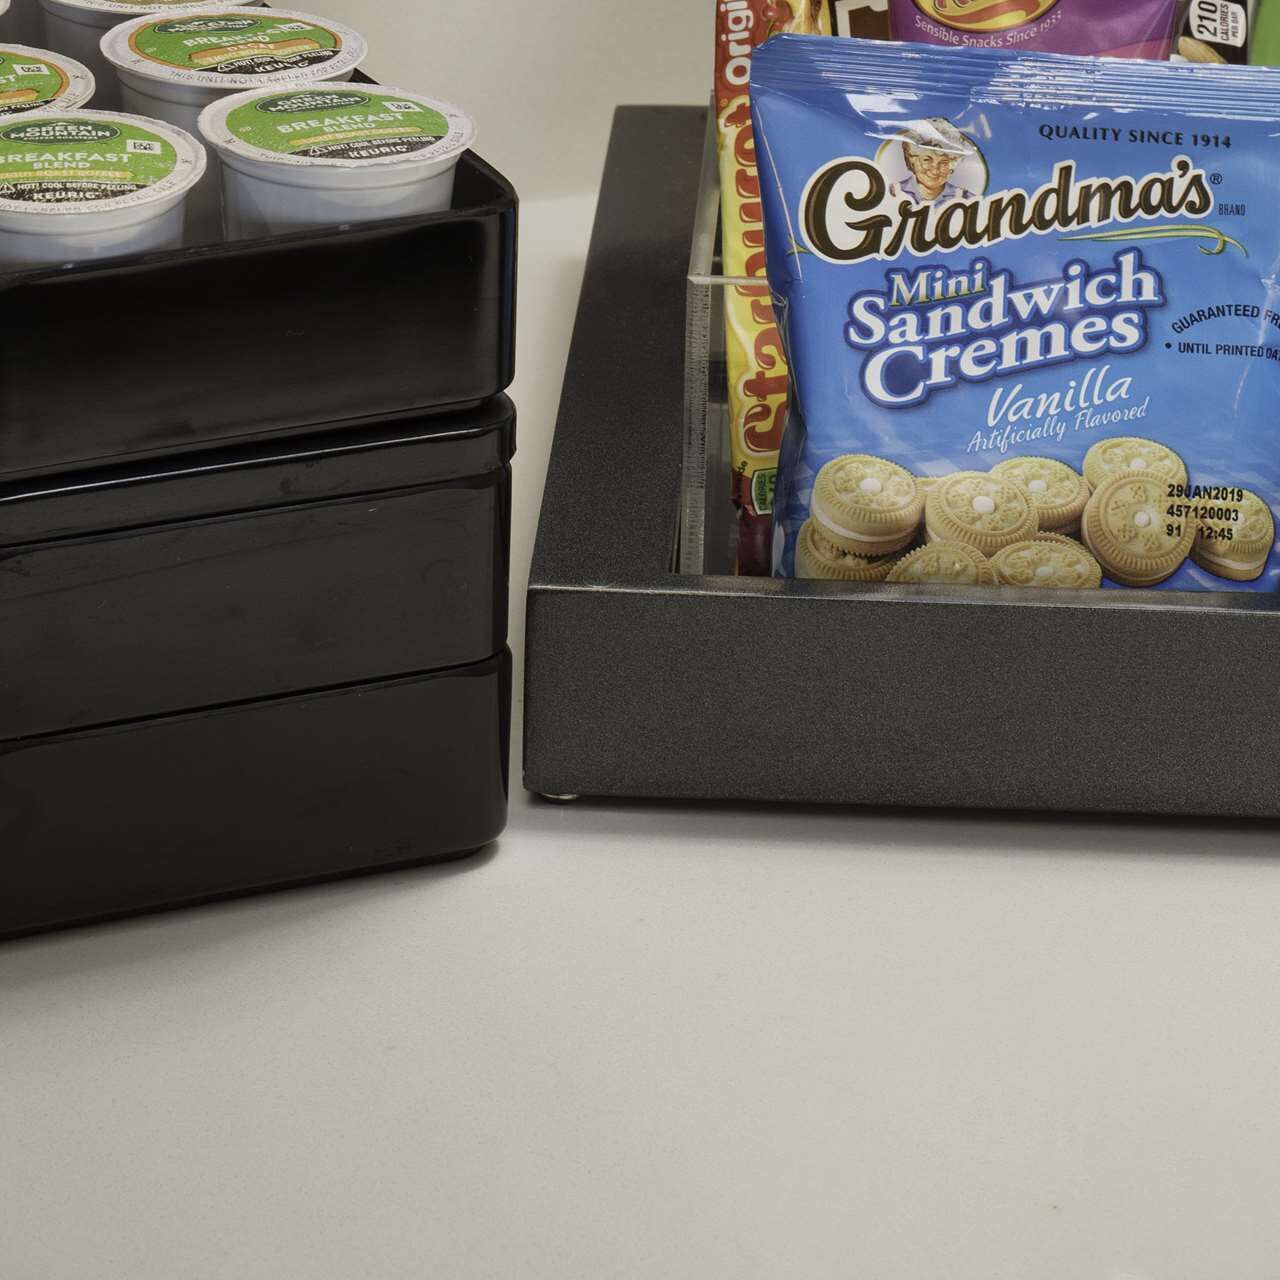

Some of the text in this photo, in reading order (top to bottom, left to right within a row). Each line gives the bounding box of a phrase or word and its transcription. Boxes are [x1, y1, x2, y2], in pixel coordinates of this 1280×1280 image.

[1196, 0, 1217, 37] 210
[1219, 2, 1229, 41] CALORIES
[915, 15, 960, 45] Sensible
[962, 34, 1003, 48] Snacks
[1006, 27, 1037, 46] Since
[25, 124, 93, 133] GREEN
[276, 112, 406, 134] BREAKFAST
[323, 123, 376, 134] BLEND
[9, 130, 111, 138] MOUNTAIN
[1038, 124, 1233, 148] QUALITY SINCE 1914
[349, 145, 408, 159] KEURIG
[32, 161, 91, 170] BLEND
[17, 182, 138, 192] HOT! COOL BEFORE PEELING
[33, 190, 99, 200] KEURIG
[805, 160, 1213, 260] Grandma's
[1218, 203, 1246, 216] BRAND
[888, 261, 986, 307] Mini
[849, 252, 1160, 345] Sandwich
[1171, 304, 1260, 334] GUARANTEED
[865, 310, 1140, 407] Cremes
[1178, 342, 1212, 354] UNTIL
[1216, 344, 1264, 358] PRINTED
[987, 364, 1132, 427] Vanilla
[967, 396, 1150, 454] Artificially Flavored
[1167, 484, 1243, 502] 29JAN2019
[1167, 504, 1239, 521] 457120003
[1166, 524, 1233, 540] 91 12:45
